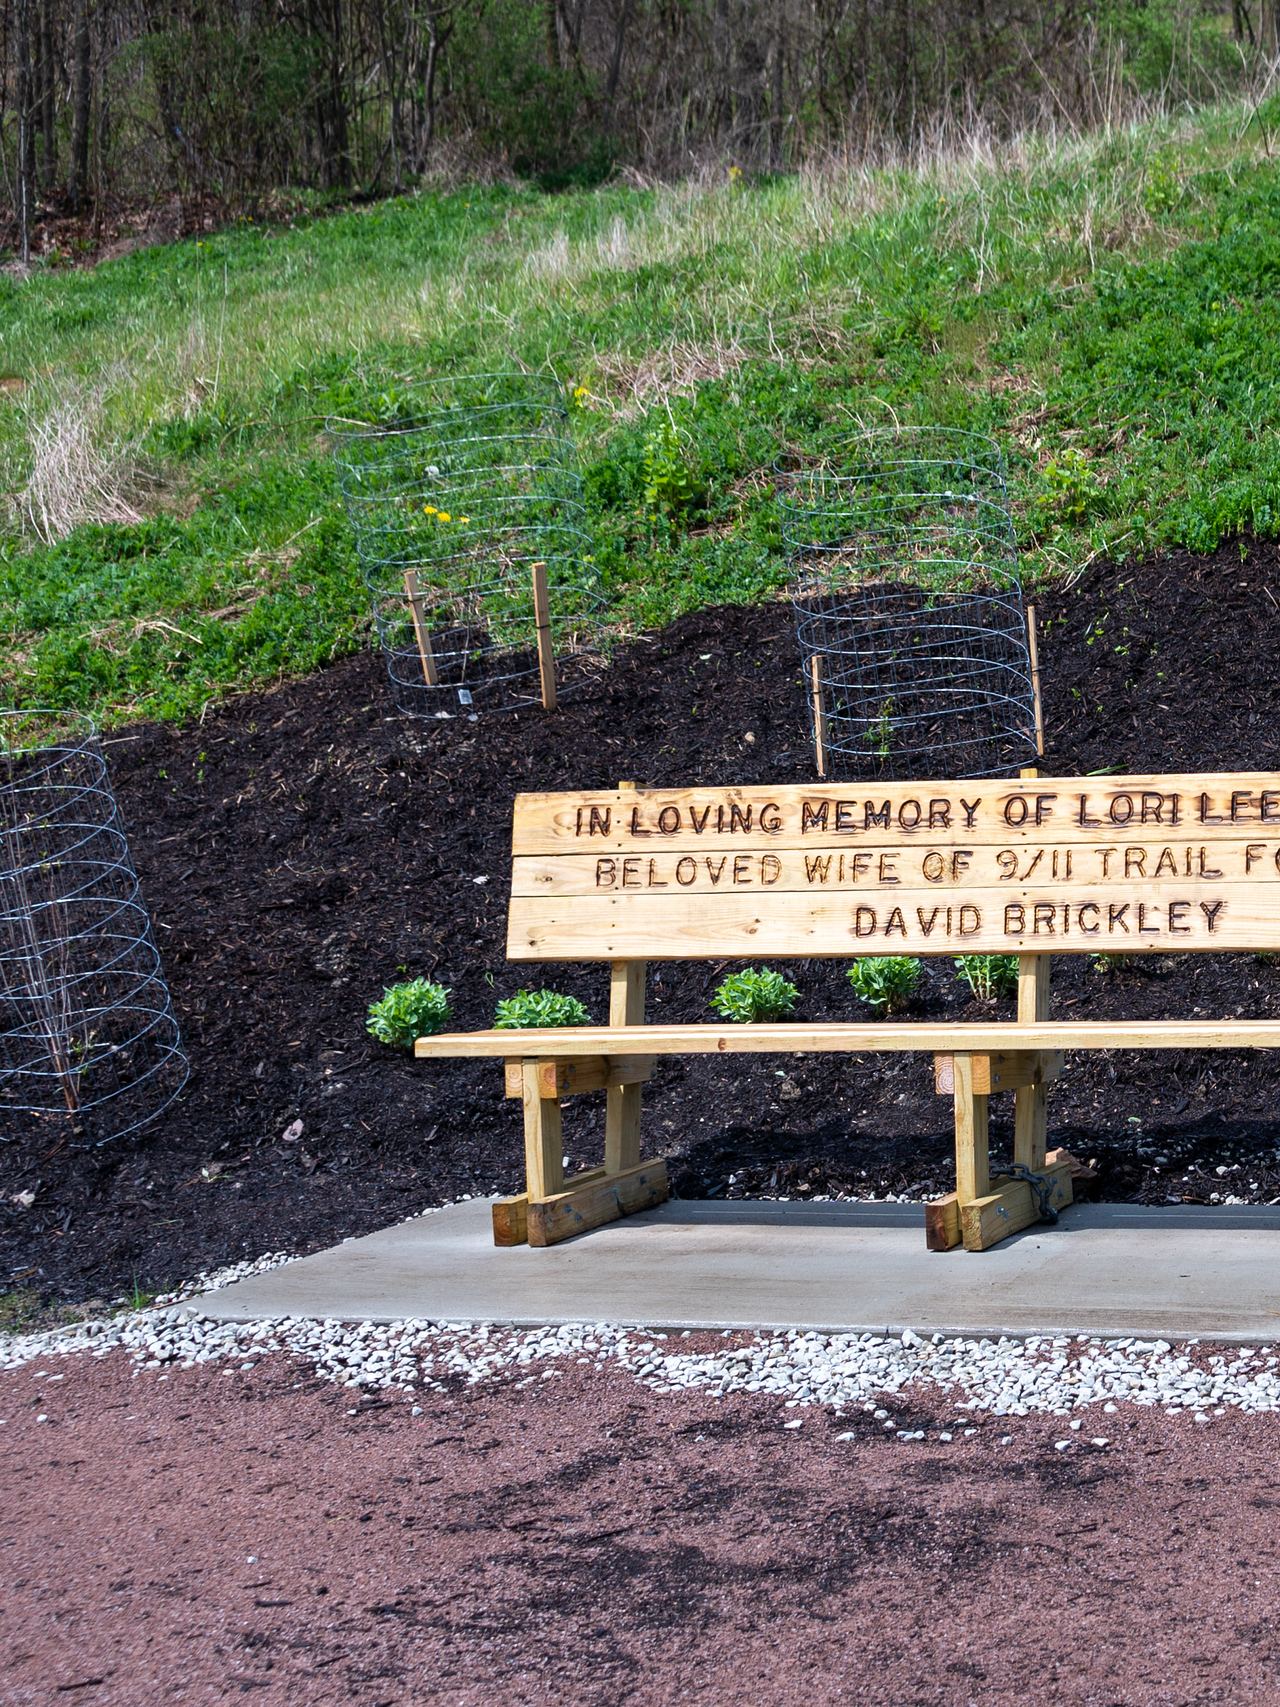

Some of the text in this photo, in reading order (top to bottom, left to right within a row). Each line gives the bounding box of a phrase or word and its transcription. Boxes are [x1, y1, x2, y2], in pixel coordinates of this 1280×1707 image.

[576, 806, 612, 838] IN
[630, 802, 783, 837] LOVING
[801, 797, 982, 834] MEMORY
[1003, 793, 1058, 827] OF
[1079, 793, 1179, 827] LORI
[595, 854, 783, 889] BELOVED
[804, 852, 901, 884] WIFE
[921, 850, 974, 881] OF
[996, 849, 1074, 881] 9/11
[1095, 845, 1223, 879] TRAIL
[855, 899, 1224, 938] DAVID BRICKLEY
